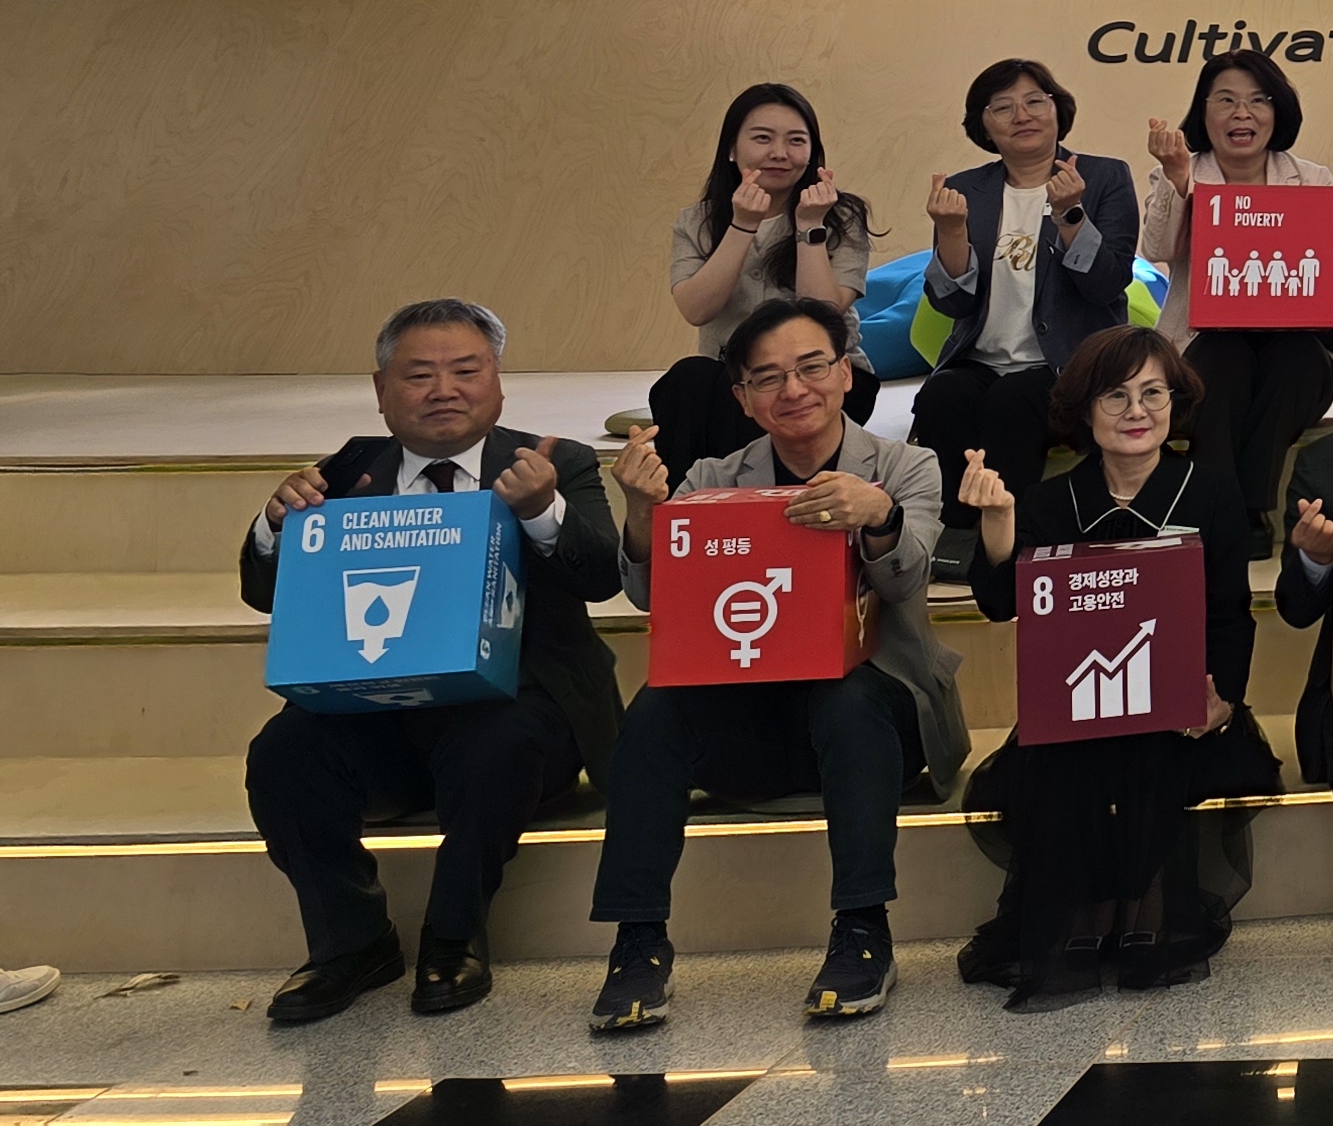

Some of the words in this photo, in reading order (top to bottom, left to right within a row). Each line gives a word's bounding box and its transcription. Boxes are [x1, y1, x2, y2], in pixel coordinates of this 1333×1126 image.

[1209, 195, 1221, 226] 1
[1235, 196, 1251, 210] NO
[1234, 213, 1285, 227] POVERTY
[342, 510, 391, 530] CLEAN
[393, 507, 443, 526] WATER
[301, 513, 326, 553] 6
[340, 531, 372, 552] AND
[374, 527, 462, 550] SANITATION
[670, 518, 691, 558] 5
[704, 539, 719, 556] 성
[721, 537, 752, 555] 평등
[1068, 567, 1139, 591] 경제성장과
[1032, 576, 1054, 615] 8
[1068, 591, 1125, 612] 고용안전
